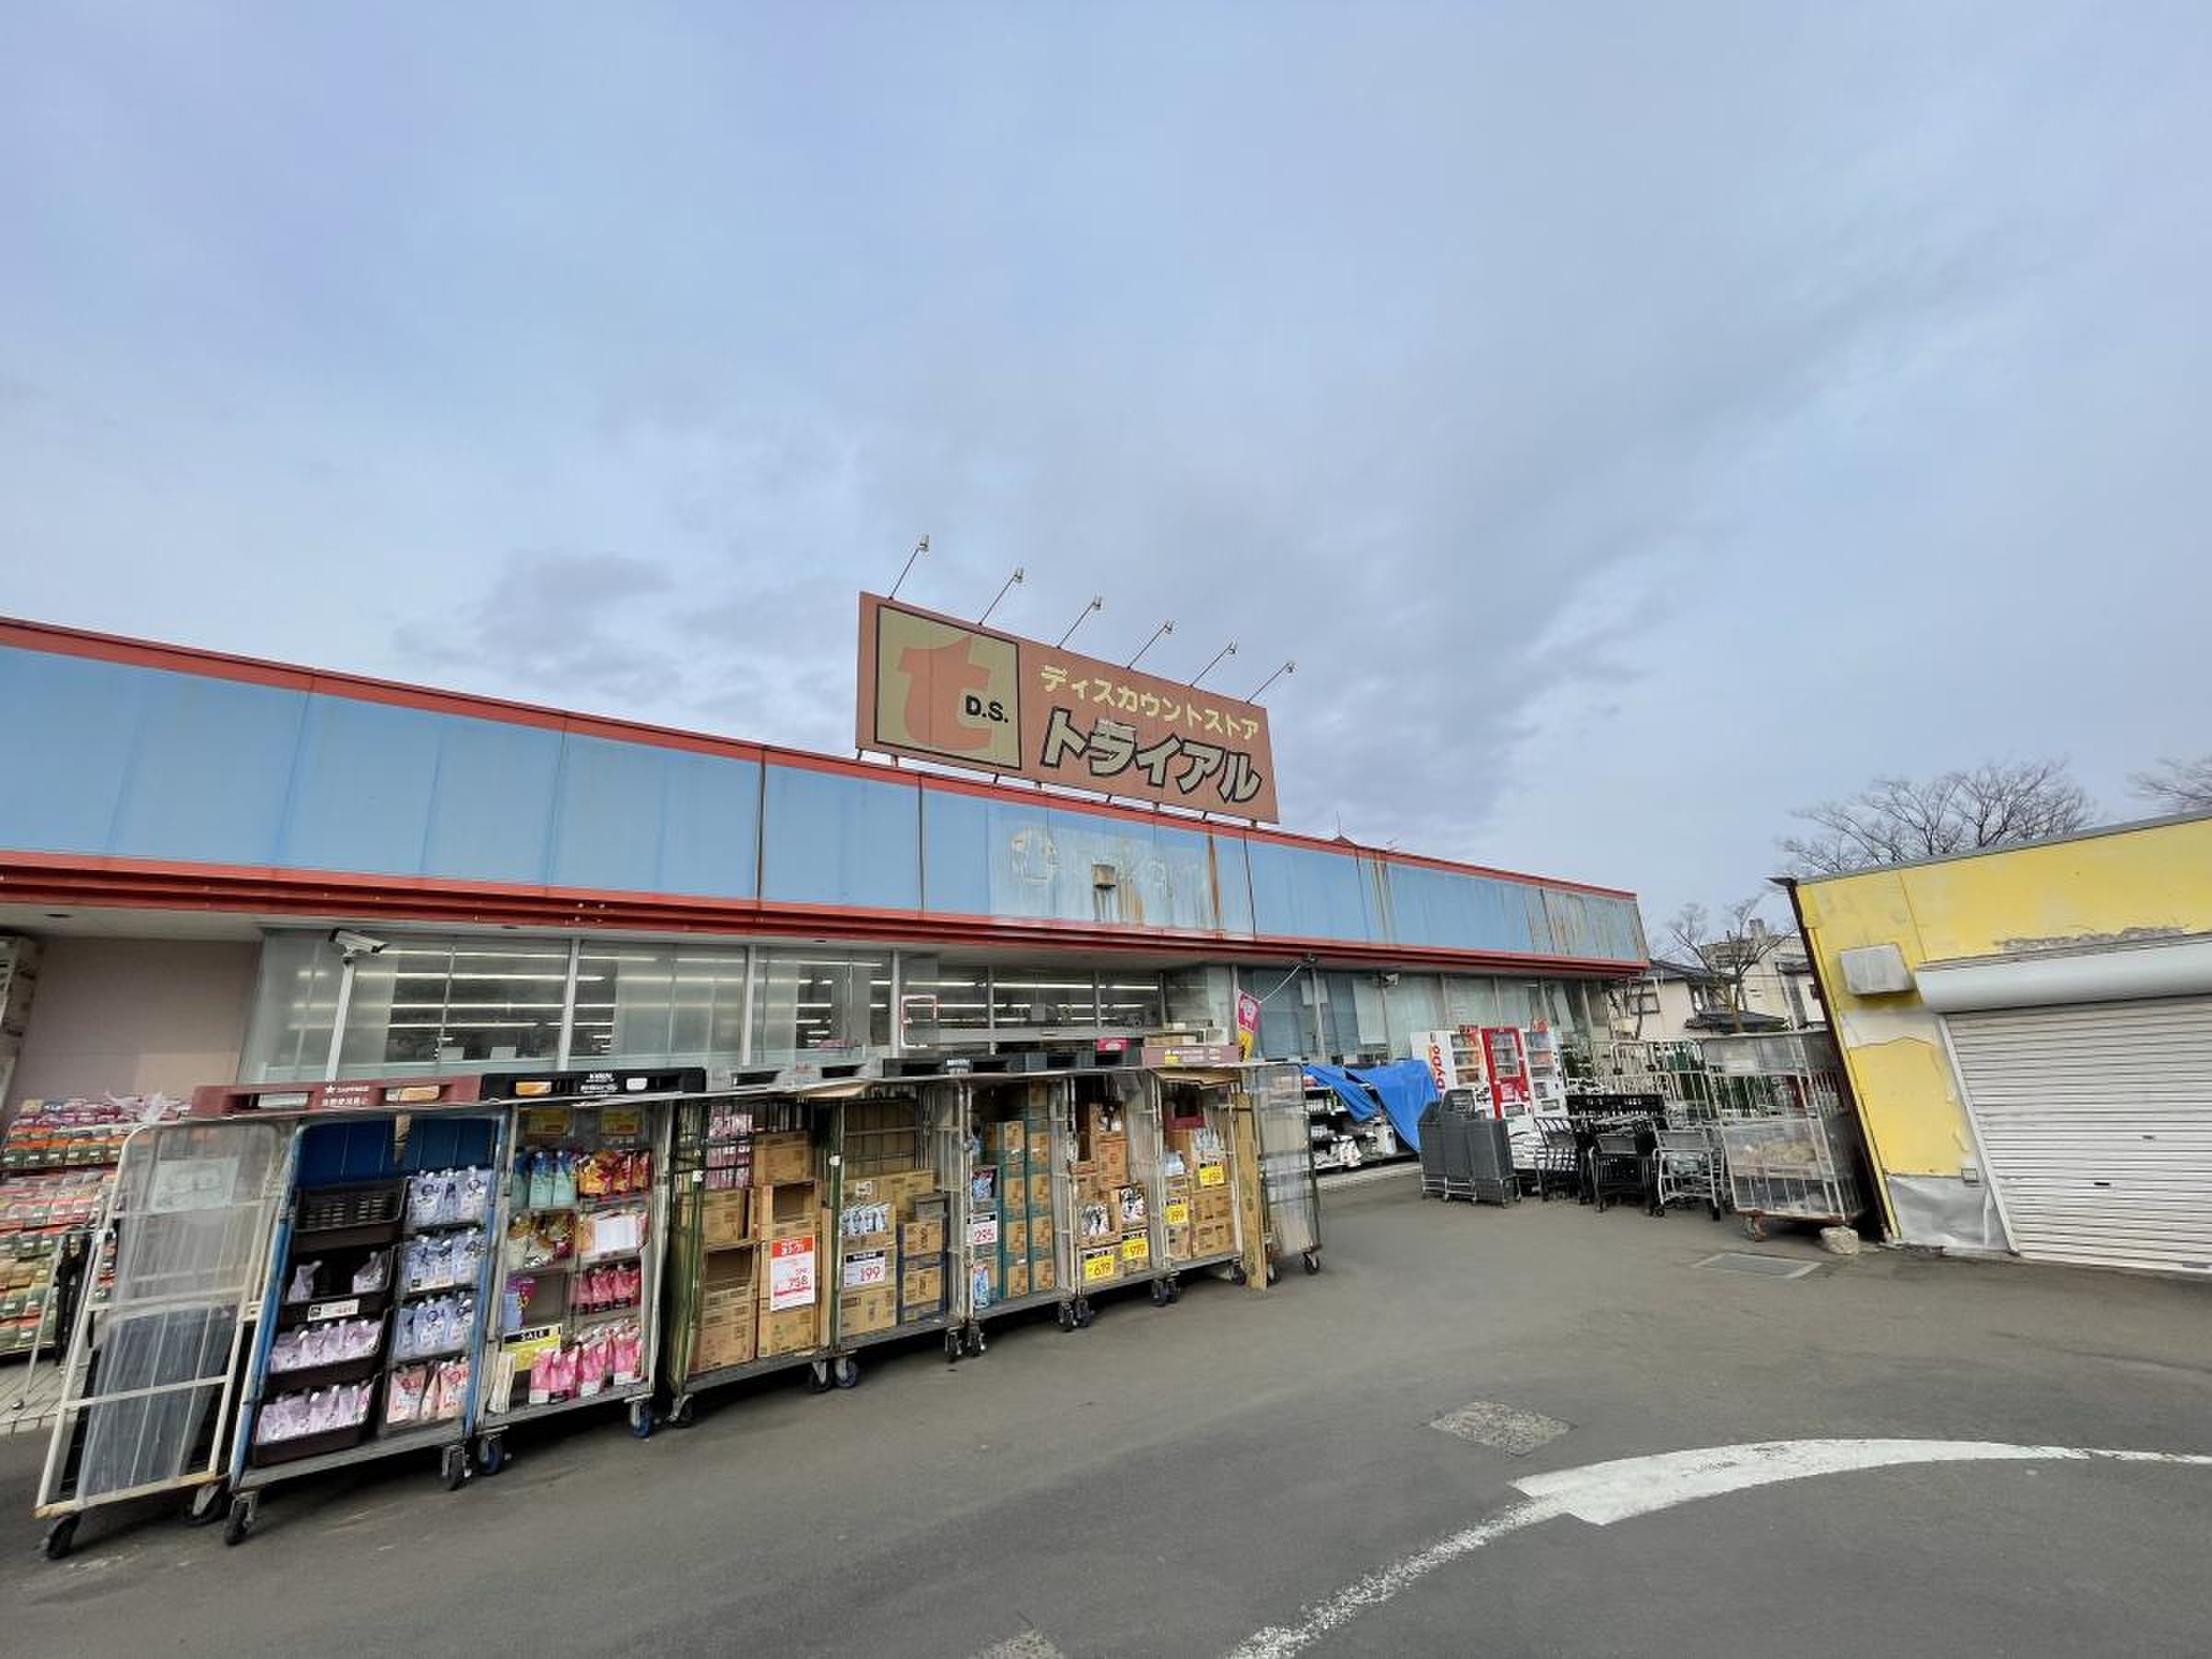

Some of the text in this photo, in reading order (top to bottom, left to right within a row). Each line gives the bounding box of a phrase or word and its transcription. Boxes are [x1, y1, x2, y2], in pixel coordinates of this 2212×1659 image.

[965, 694, 1010, 724] D.S.
[1041, 664, 1259, 741] ディスカウントストア
[1040, 707, 1263, 804] トライアル
